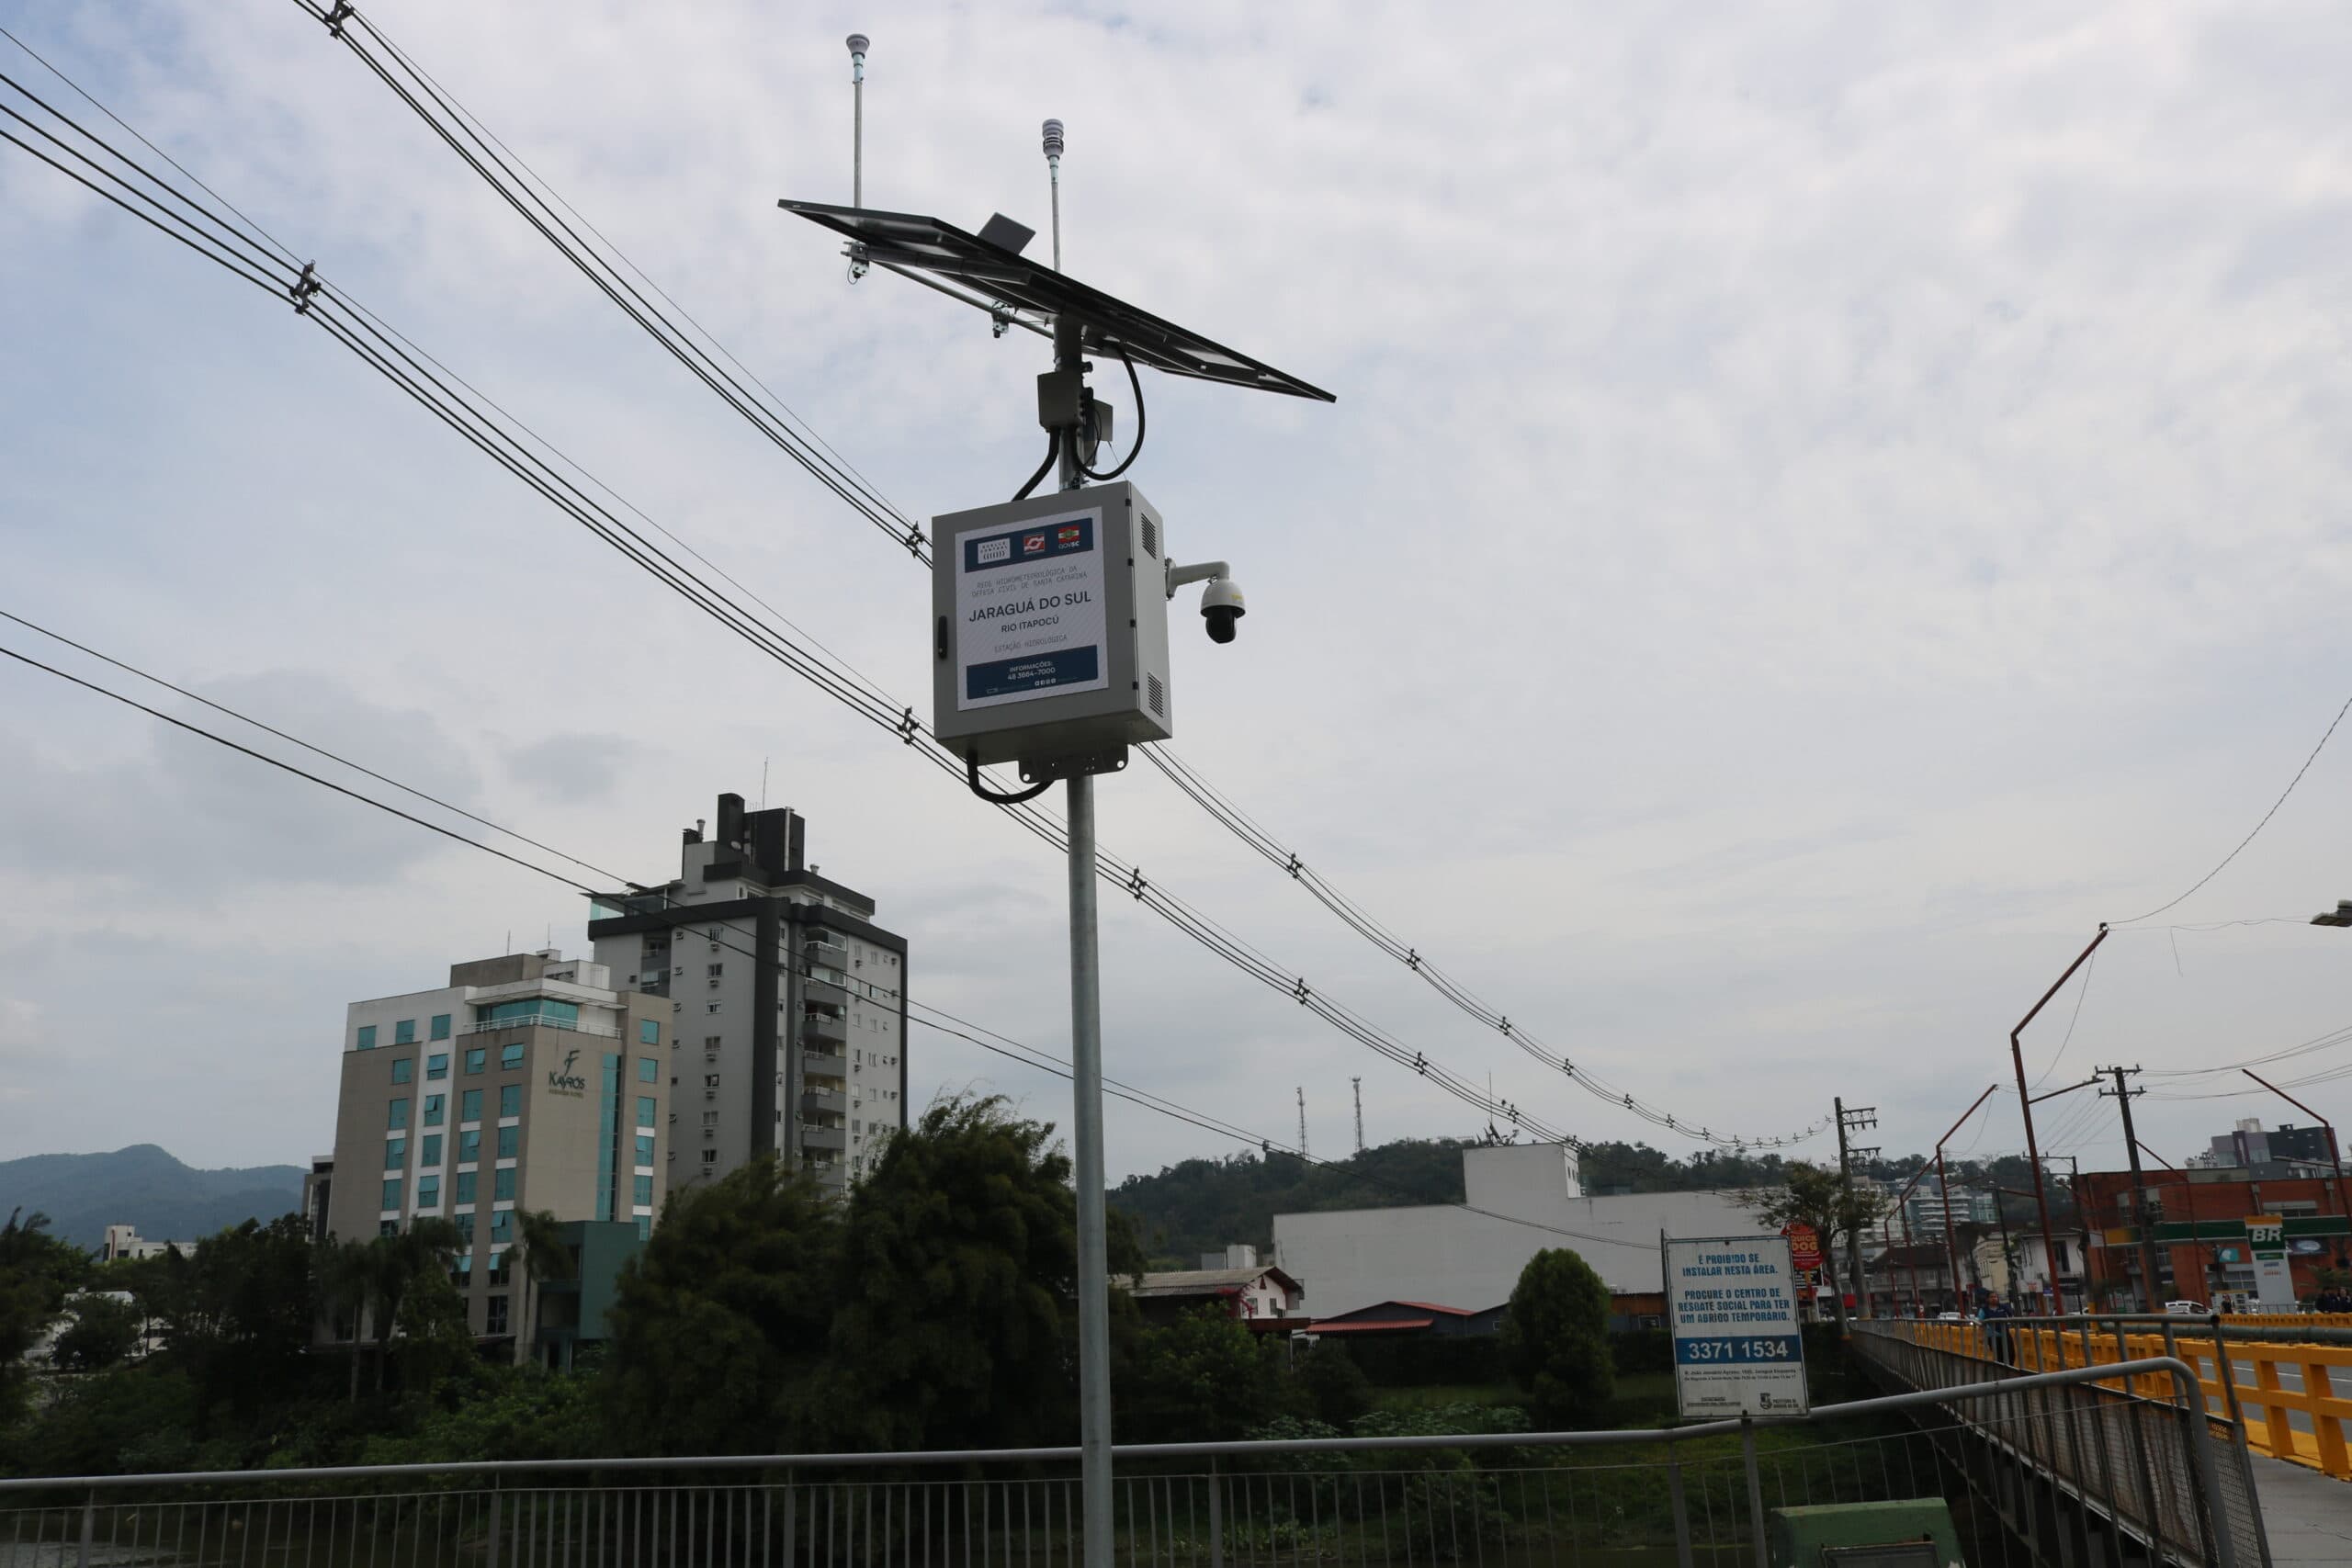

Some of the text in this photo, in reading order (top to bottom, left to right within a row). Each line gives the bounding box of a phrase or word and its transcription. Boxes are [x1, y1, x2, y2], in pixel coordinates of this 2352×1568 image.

[969, 591, 1091, 622] JARAGUÁ DO SUL
[1001, 623, 1016, 632] RIO
[2252, 1228, 2282, 1242] BR
[1792, 1241, 1819, 1250] DOG
[1706, 1254, 1746, 1264] PROIBIDO
[1748, 1253, 1759, 1263] SE
[1682, 1267, 1723, 1277] INSTALAR
[1724, 1265, 1751, 1276] NESTA
[1684, 1288, 1781, 1300] PROCURE O CENTRO DE
[1717, 1301, 1747, 1311] SOCIAL
[1749, 1300, 1772, 1310] PARA
[1774, 1299, 1790, 1309] TER
[1680, 1314, 1695, 1324] UM
[1697, 1313, 1729, 1323] ABRIGO
[1689, 1340, 1789, 1359] 3371 1534
